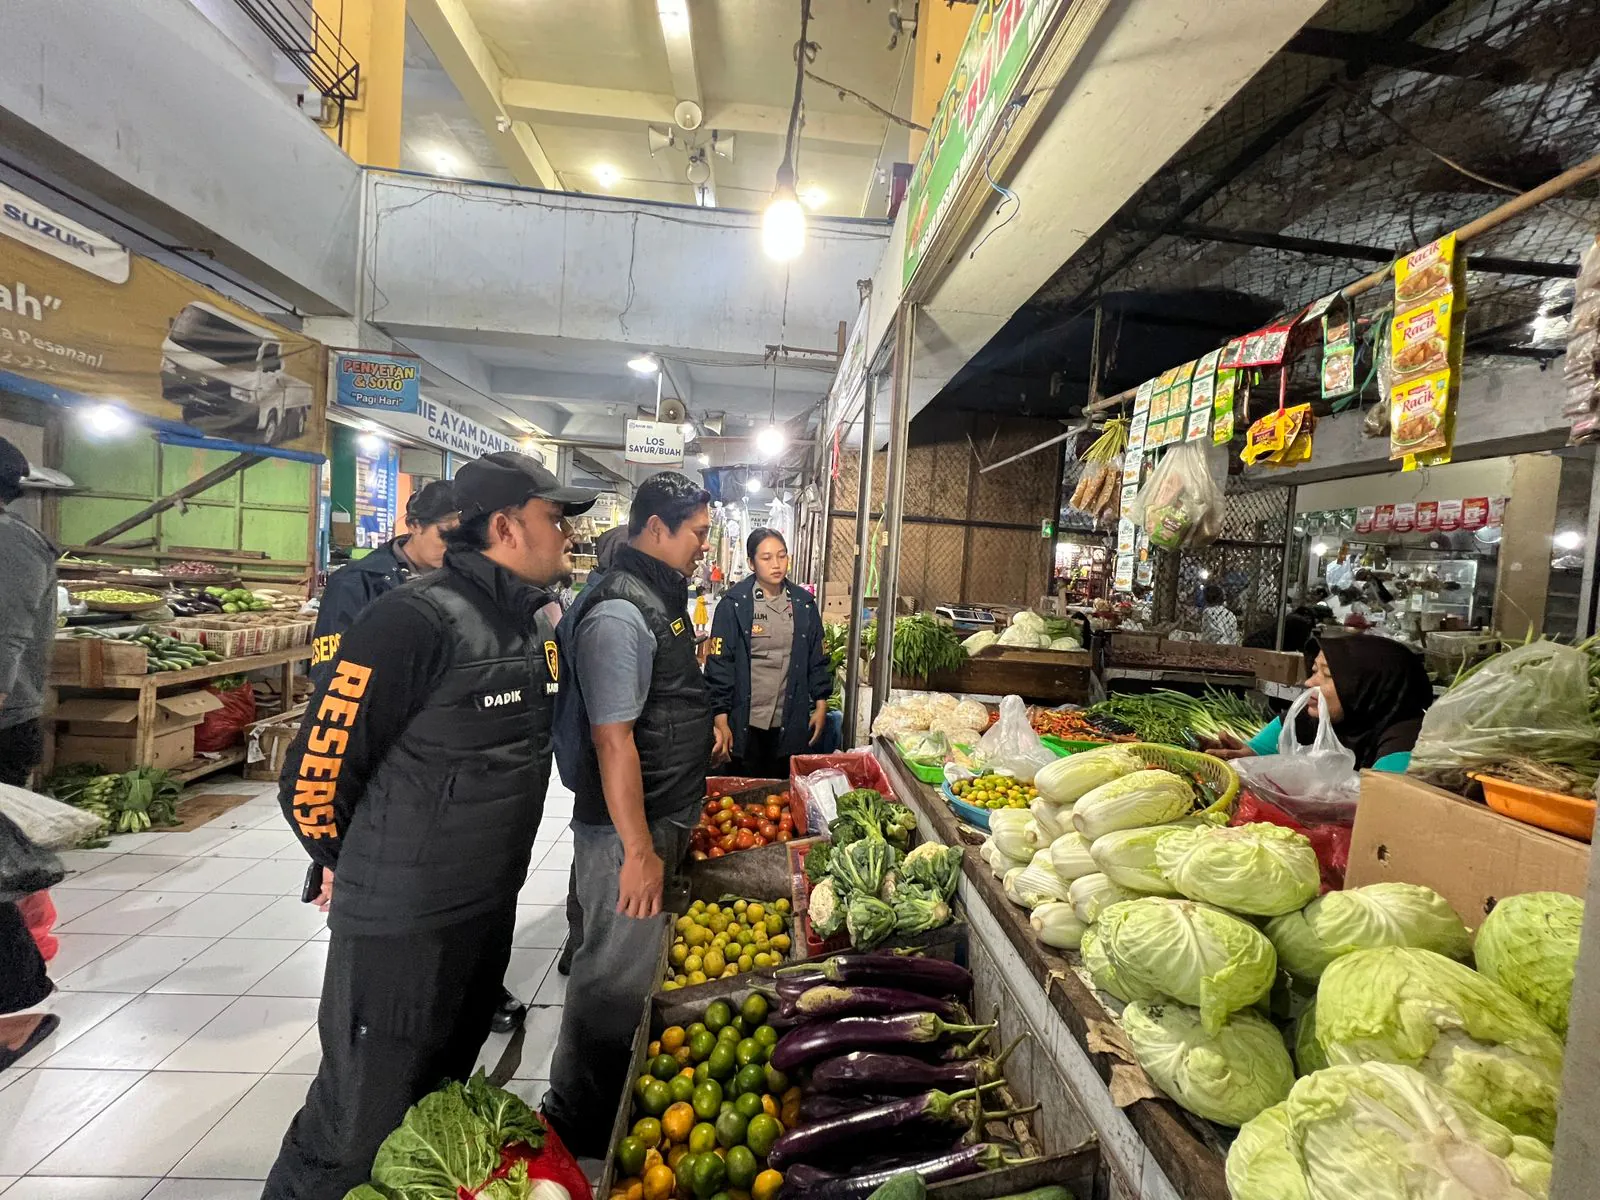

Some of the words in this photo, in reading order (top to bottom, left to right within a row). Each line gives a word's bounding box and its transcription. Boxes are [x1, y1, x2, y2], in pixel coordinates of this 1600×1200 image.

[3, 203, 95, 257] SUZUKI
[1407, 242, 1440, 270] Racik
[1403, 316, 1437, 341] Racik
[343, 360, 416, 379] PENYETAN
[354, 375, 367, 389] &
[368, 376, 403, 391] SOTO
[1403, 391, 1435, 412] Racik
[428, 426, 449, 443] CAK
[450, 435, 470, 453] NAN
[440, 411, 477, 441] AYAM
[480, 429, 502, 452] DAN
[645, 437, 664, 446] LOS
[628, 444, 681, 457] SAYUR/BUAH
[484, 690, 521, 707] DADIK
[293, 659, 373, 840] RESERSE
